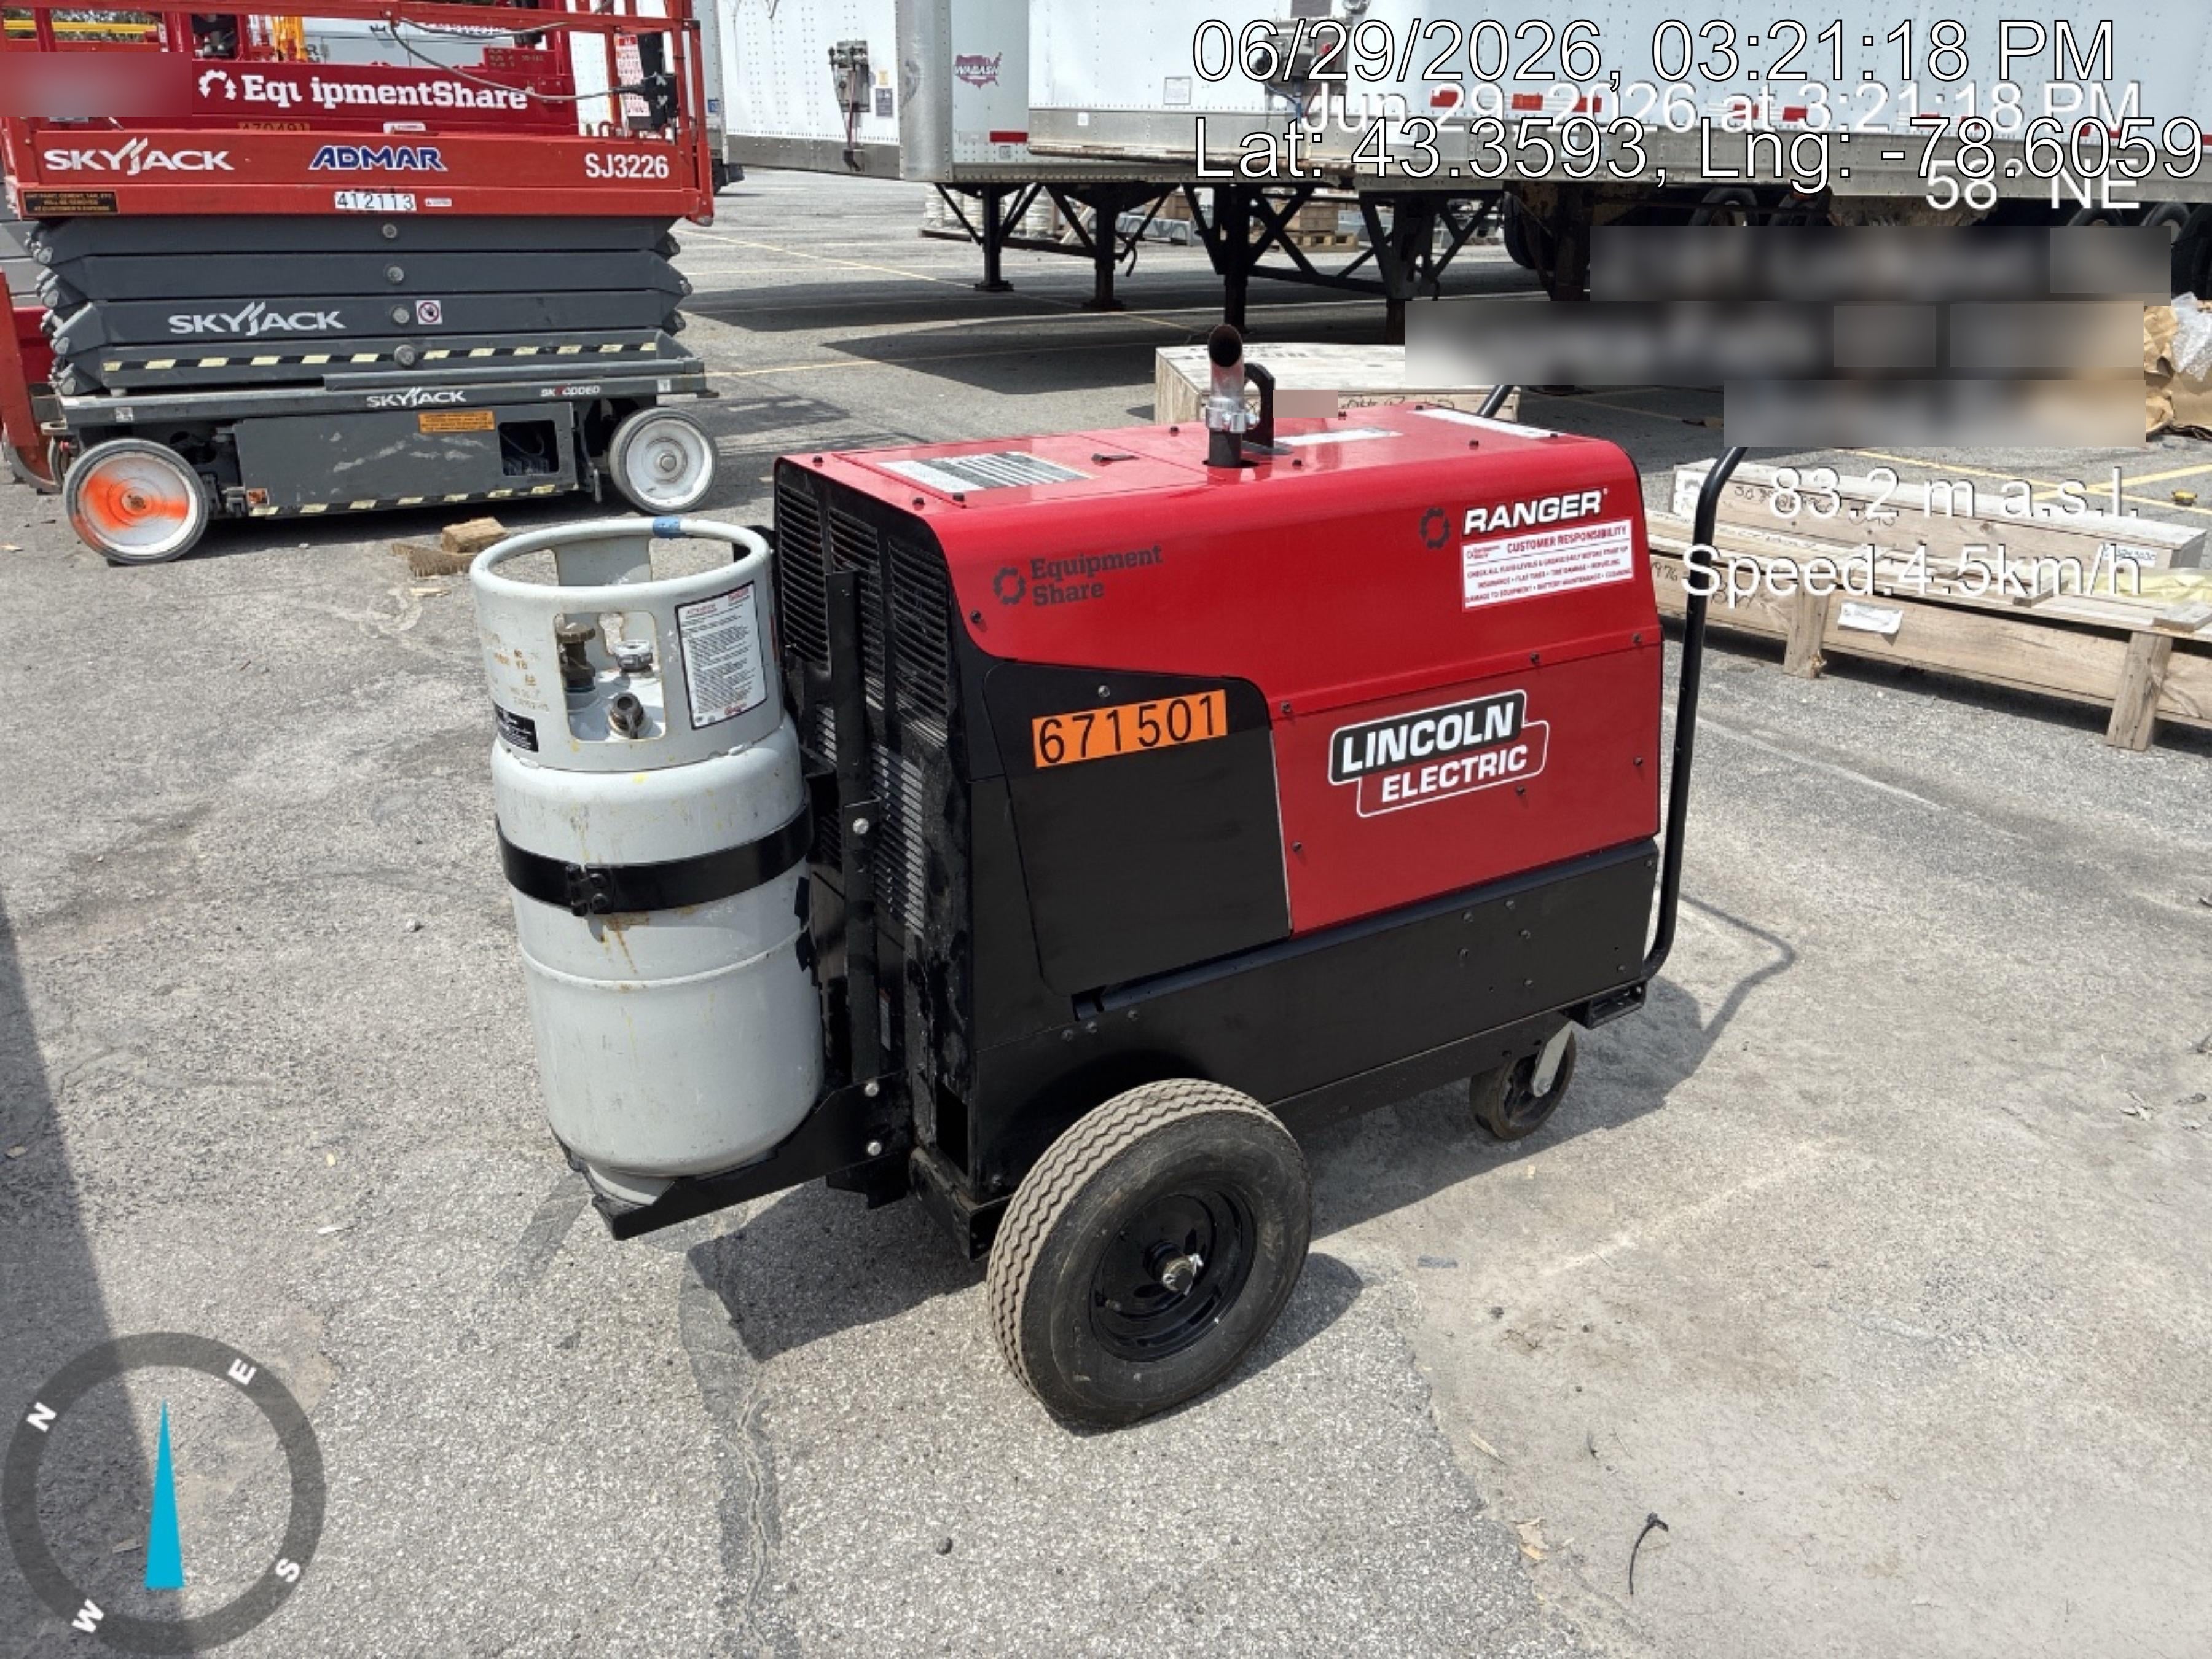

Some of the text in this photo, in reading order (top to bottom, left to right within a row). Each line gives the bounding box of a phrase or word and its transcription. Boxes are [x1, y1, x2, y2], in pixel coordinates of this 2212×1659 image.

[44, 136, 235, 176] SKYJACK
[308, 146, 448, 171] ADMAR
[585, 152, 670, 178] SJ3226
[336, 193, 414, 210] 412113
[167, 301, 347, 336] SKYJACK
[367, 386, 467, 409] SKYJACK
[1464, 488, 1602, 536] RANGER
[1507, 525, 1627, 553] CUSTOMER RESPONSIBILITY
[1030, 544, 1164, 582] Equipment
[1032, 581, 1105, 606] Share
[1038, 694, 1214, 764] 671501
[1342, 702, 1514, 774] LINCOLN
[1381, 744, 1528, 803] ELECTRIC
